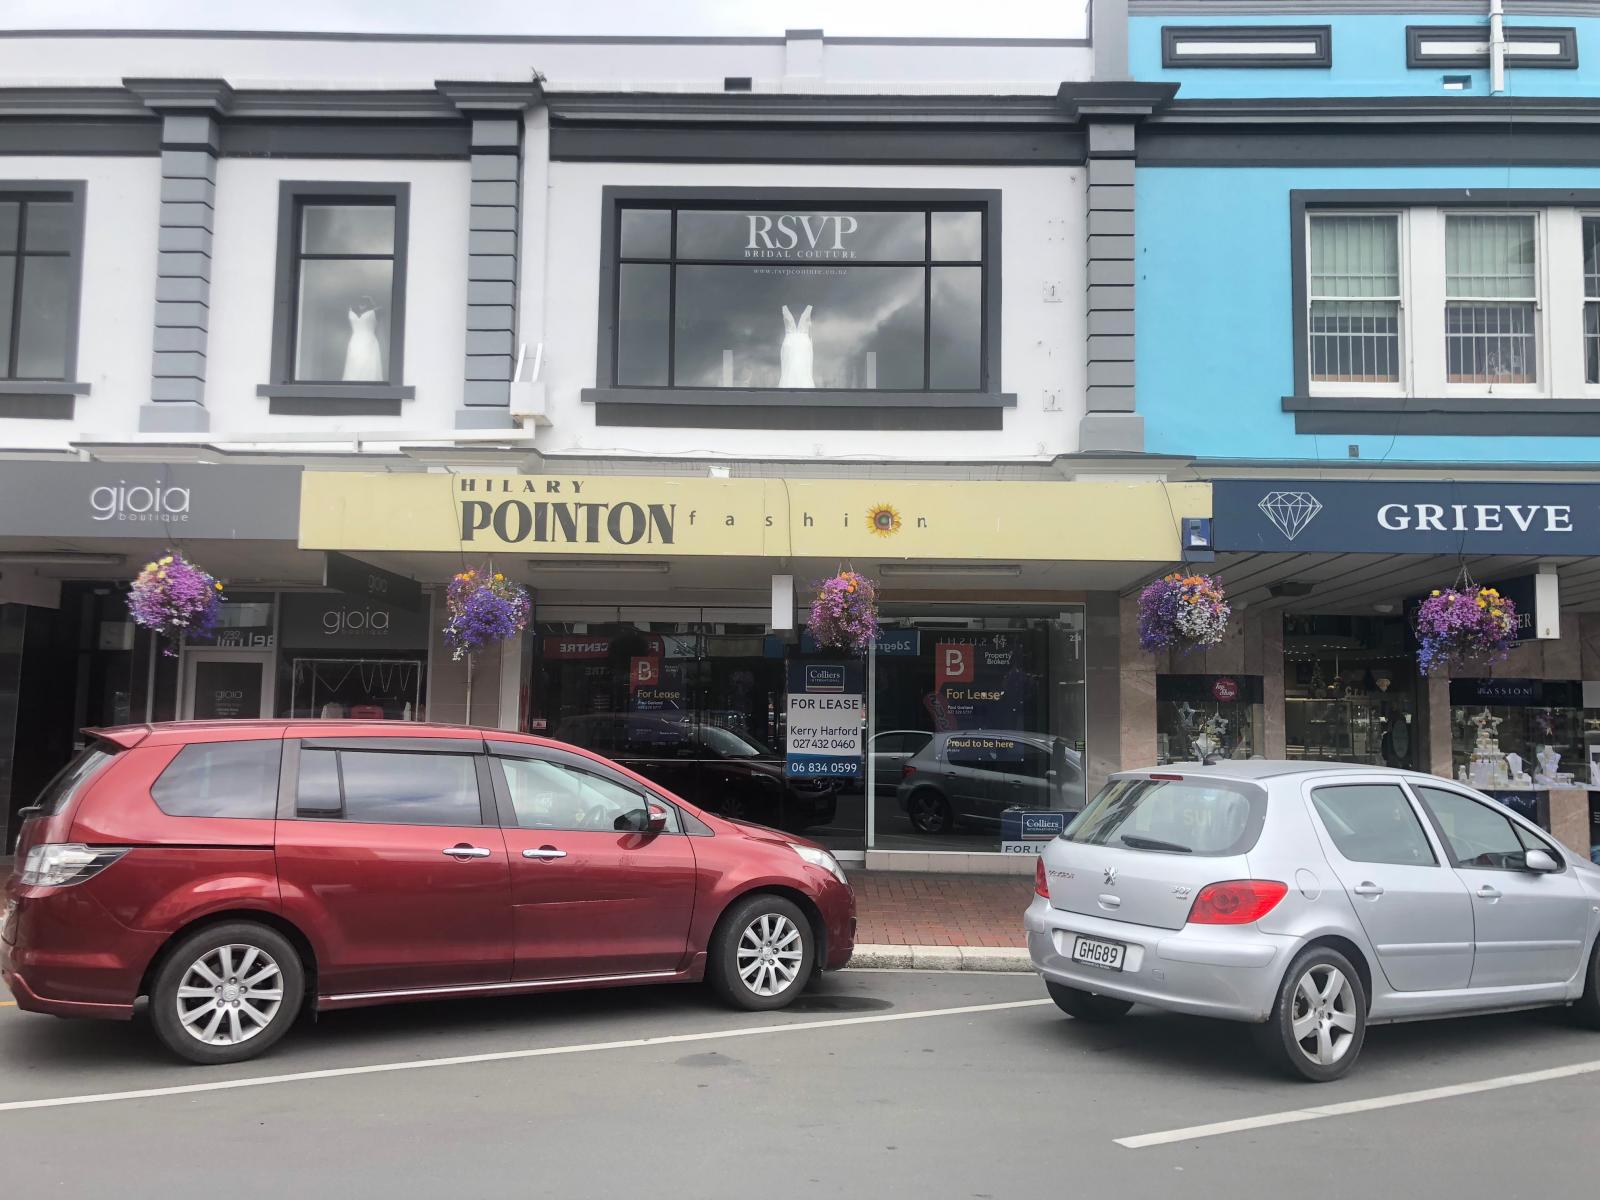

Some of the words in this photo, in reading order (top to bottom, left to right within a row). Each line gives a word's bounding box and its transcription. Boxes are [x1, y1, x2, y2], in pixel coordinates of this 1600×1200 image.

[744, 214, 859, 250] RSVP
[744, 250, 792, 258] BRIDAL
[796, 250, 857, 259] COUTURE
[460, 478, 585, 494] HILARY
[90, 479, 190, 521] gioia
[119, 513, 189, 522] boutique
[460, 499, 677, 545] POINTON
[1376, 503, 1574, 532] GRIEVE
[322, 606, 390, 635] gioia
[984, 651, 1012, 660] Property
[810, 669, 841, 679] Colliers
[637, 689, 651, 699] For
[653, 689, 681, 699] Lease
[946, 687, 965, 700] For
[967, 688, 1000, 701] Lease
[791, 698, 816, 710] FOR
[819, 699, 859, 710] LEASE
[790, 726, 818, 738] Kerry
[820, 726, 858, 736] Harford
[831, 739, 856, 749] 0460
[946, 739, 971, 748] Proud
[972, 739, 982, 748] to
[983, 739, 994, 748] be
[995, 739, 1014, 749] here
[791, 762, 805, 772] 06
[808, 762, 828, 772] 834
[830, 762, 858, 773] 0599
[1026, 818, 1059, 828] Colliers
[1005, 845, 1031, 854] FOR
[1079, 941, 1118, 964] GHG89
